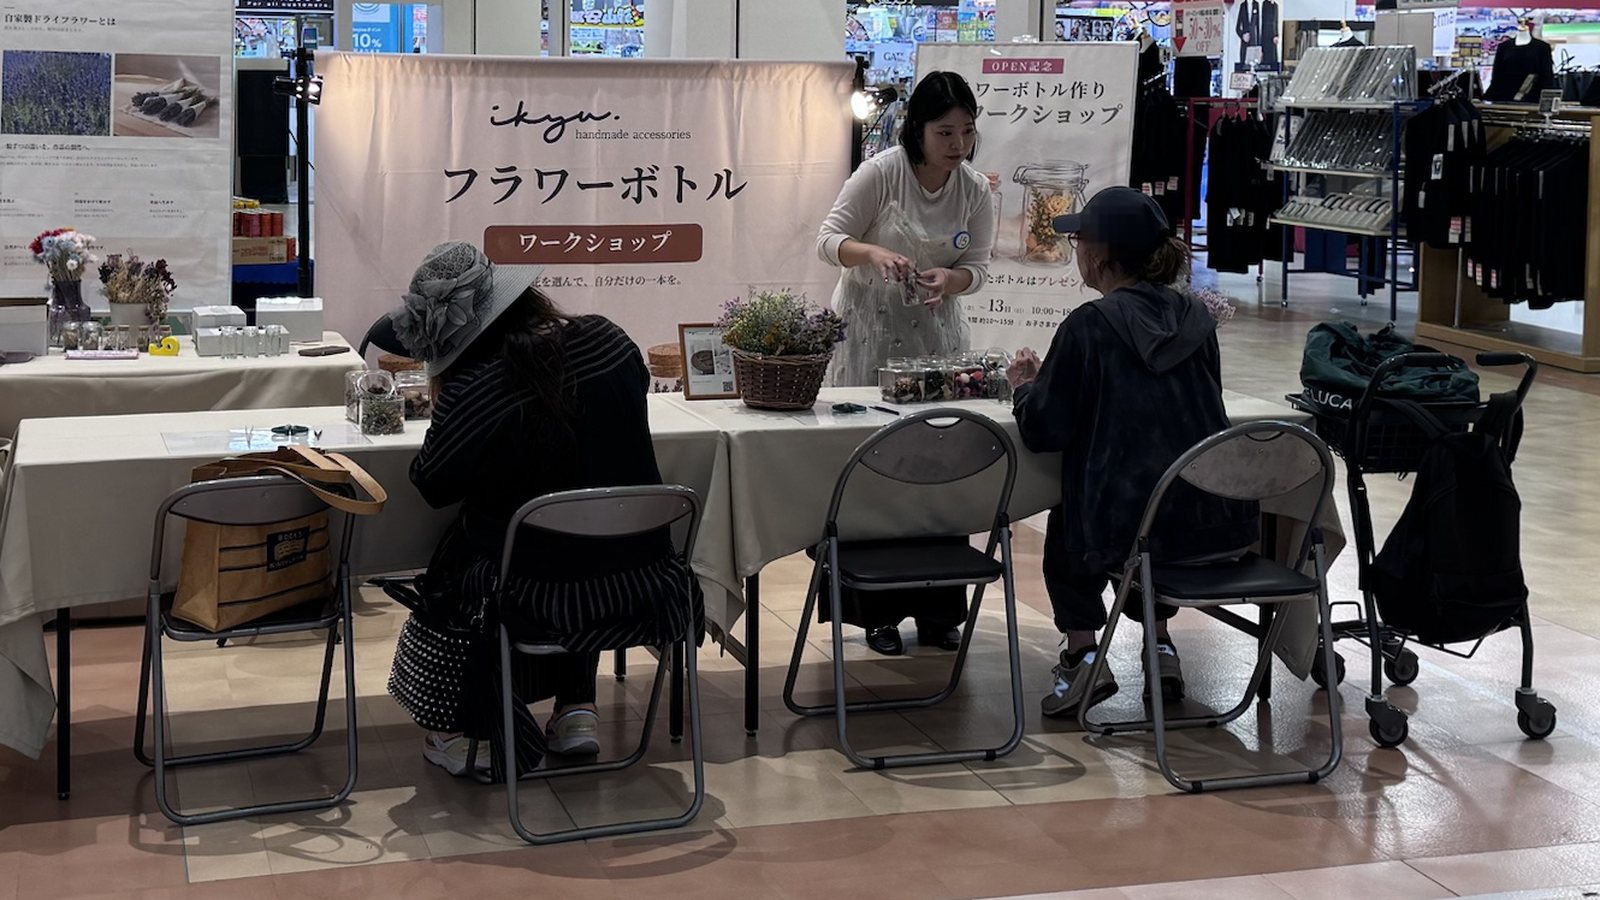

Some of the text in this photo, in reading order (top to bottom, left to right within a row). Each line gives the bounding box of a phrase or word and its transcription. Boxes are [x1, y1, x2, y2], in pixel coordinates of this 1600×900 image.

[5, 13, 117, 26] 自家製ドライフラワーとは
[352, 33, 382, 48] 10%
[991, 60, 1053, 72] OPEN記念
[965, 80, 1105, 99] ワーボトル作り
[575, 129, 691, 140] handmade accessories
[444, 164, 748, 205] フラワーボトル
[519, 230, 673, 254] ワークショップ
